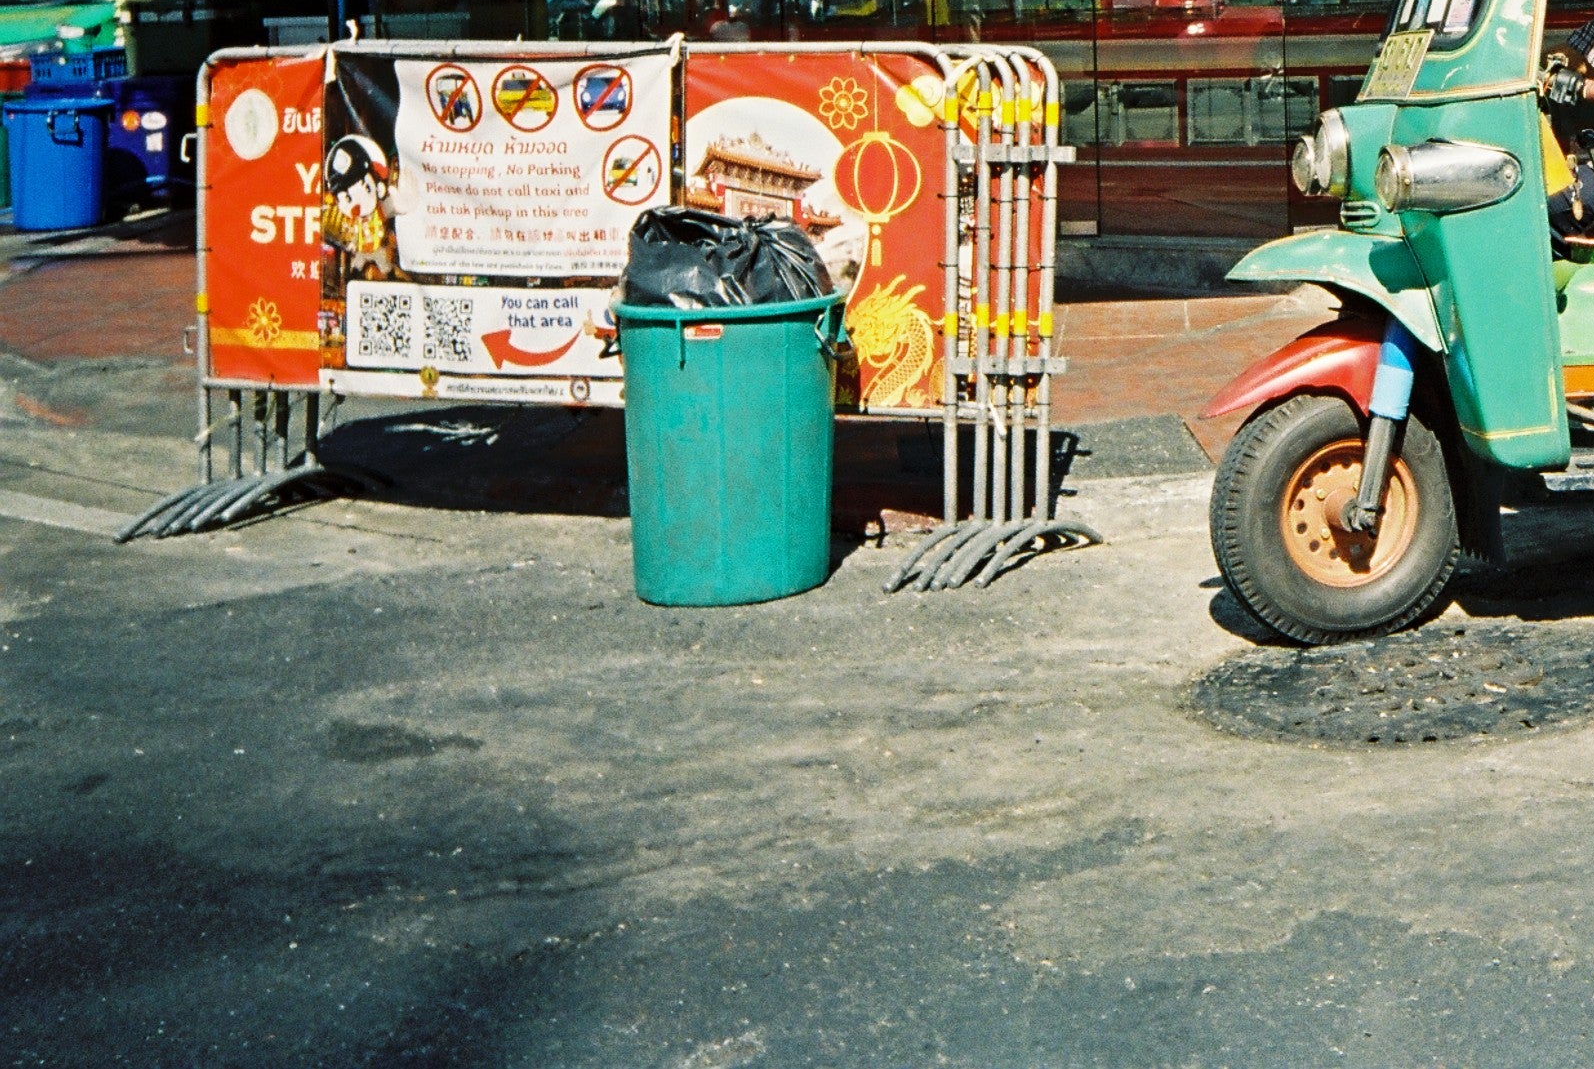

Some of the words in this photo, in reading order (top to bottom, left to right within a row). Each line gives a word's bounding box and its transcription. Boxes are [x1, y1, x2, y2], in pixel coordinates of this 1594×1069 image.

[421, 134, 494, 161] ห้ามหยุด
[421, 162, 437, 174] No
[506, 164, 523, 175] No
[527, 164, 581, 180] Parking
[426, 182, 462, 196] Please
[465, 183, 479, 196] do
[483, 186, 502, 197] not
[507, 184, 530, 197] call
[535, 184, 560, 197] taxi
[565, 183, 590, 197] and
[426, 203, 446, 214] tuk
[451, 205, 470, 215] tuk
[474, 205, 512, 220] pickup
[516, 206, 529, 218] in
[532, 205, 558, 218] this
[563, 207, 588, 218] area
[501, 296, 523, 310] You
[526, 297, 548, 310] can
[553, 296, 578, 309] call
[508, 314, 535, 328] that
[541, 315, 573, 327] area
